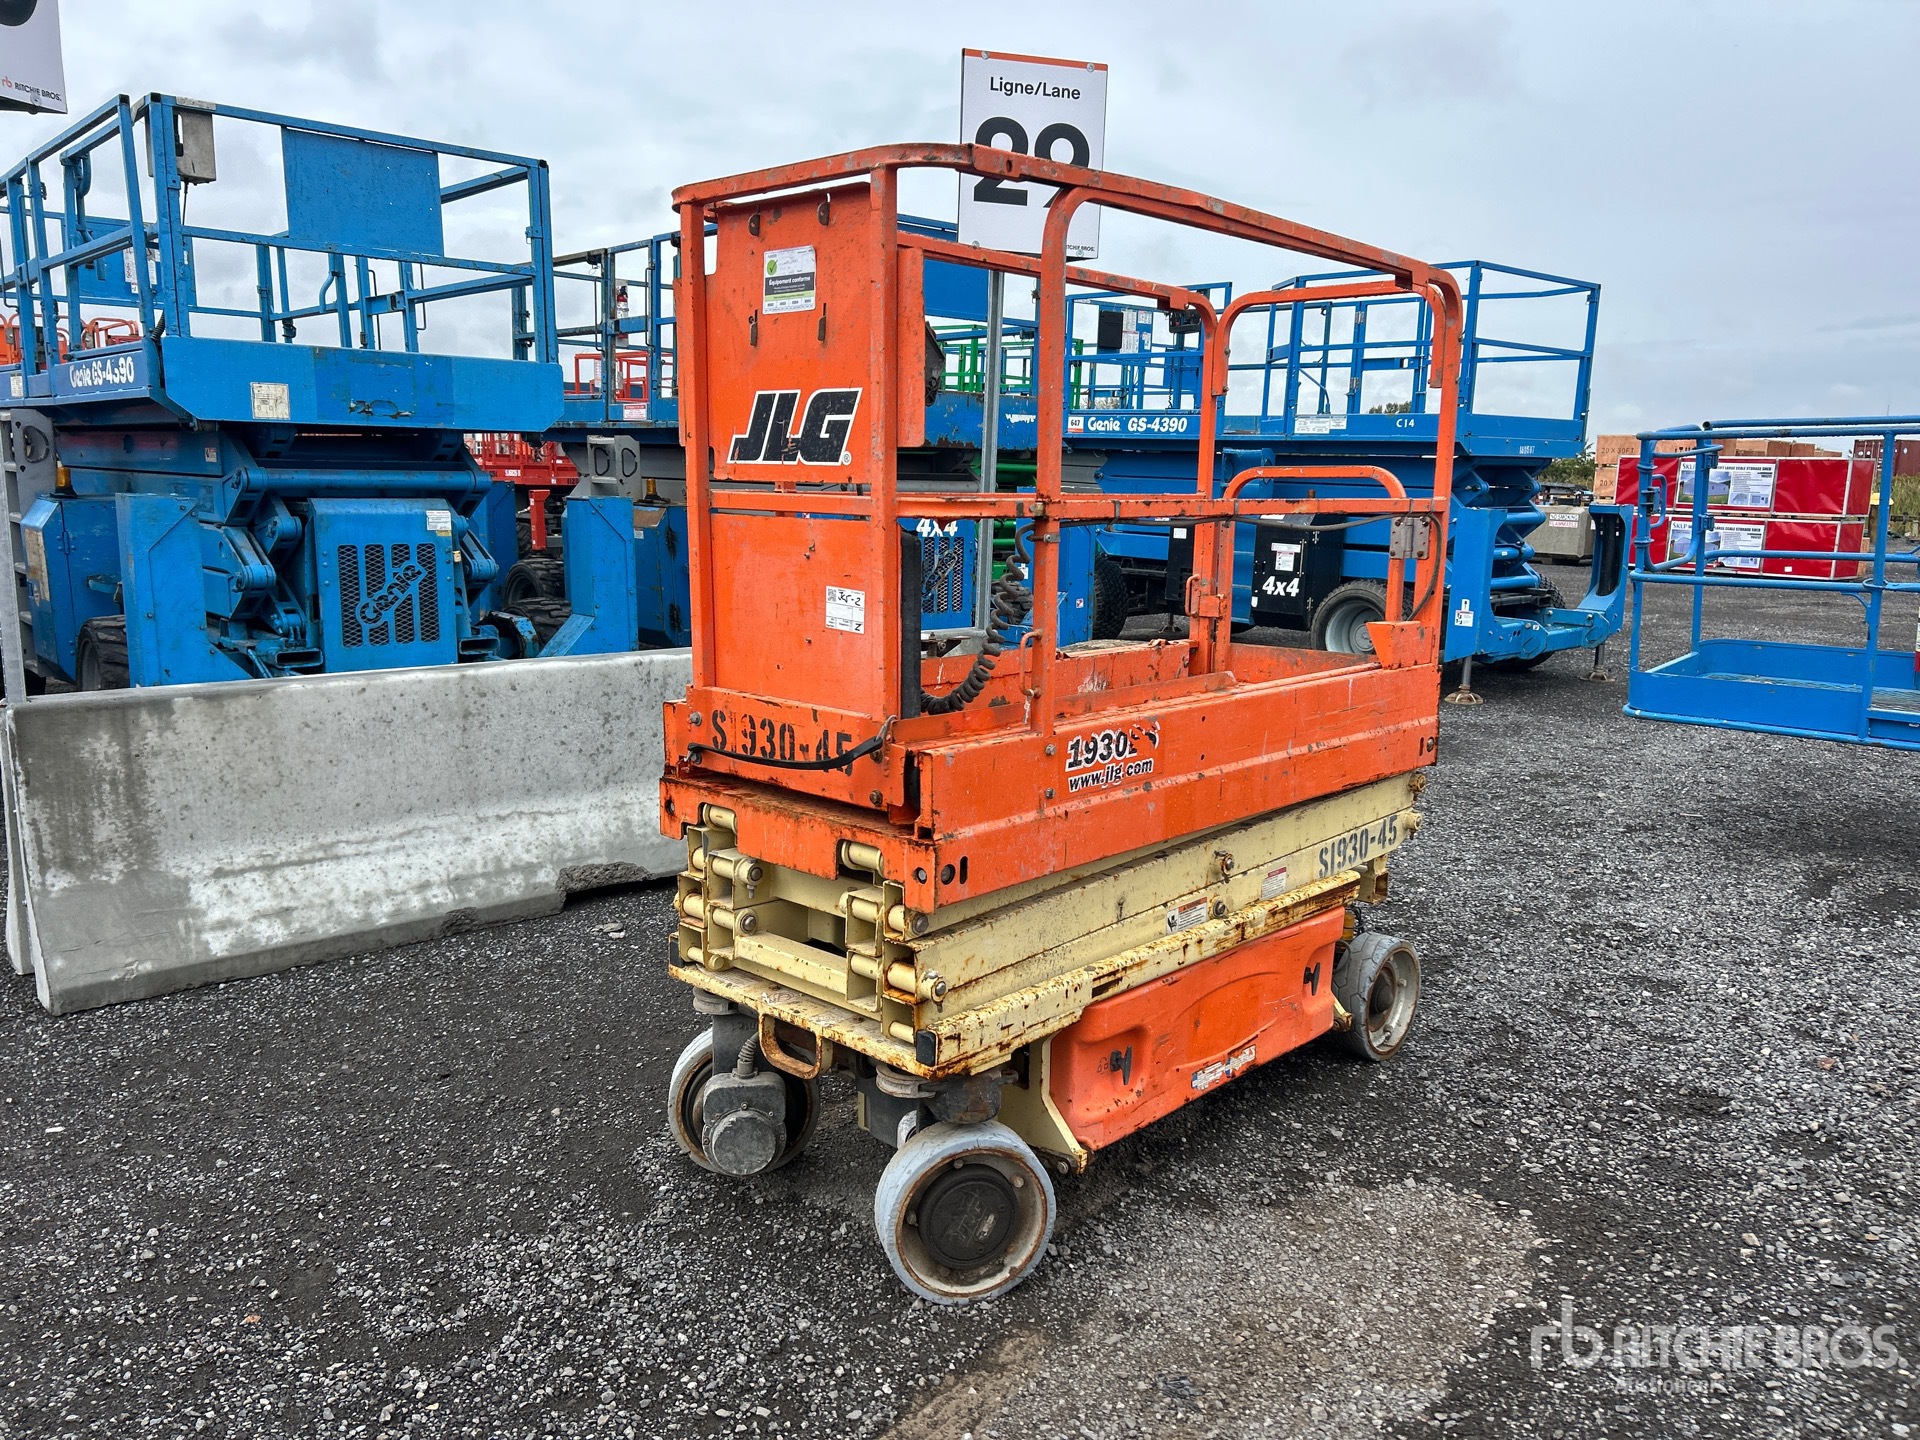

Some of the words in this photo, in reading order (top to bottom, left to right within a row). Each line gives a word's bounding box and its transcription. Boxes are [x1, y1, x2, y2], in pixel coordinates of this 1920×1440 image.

[990, 76, 1081, 100] Ligne/Lane
[726, 387, 863, 466] JLG
[1087, 416, 1121, 432] Genie
[1127, 417, 1188, 433] GS-4390
[1068, 757, 1155, 793] www.jlg.com
